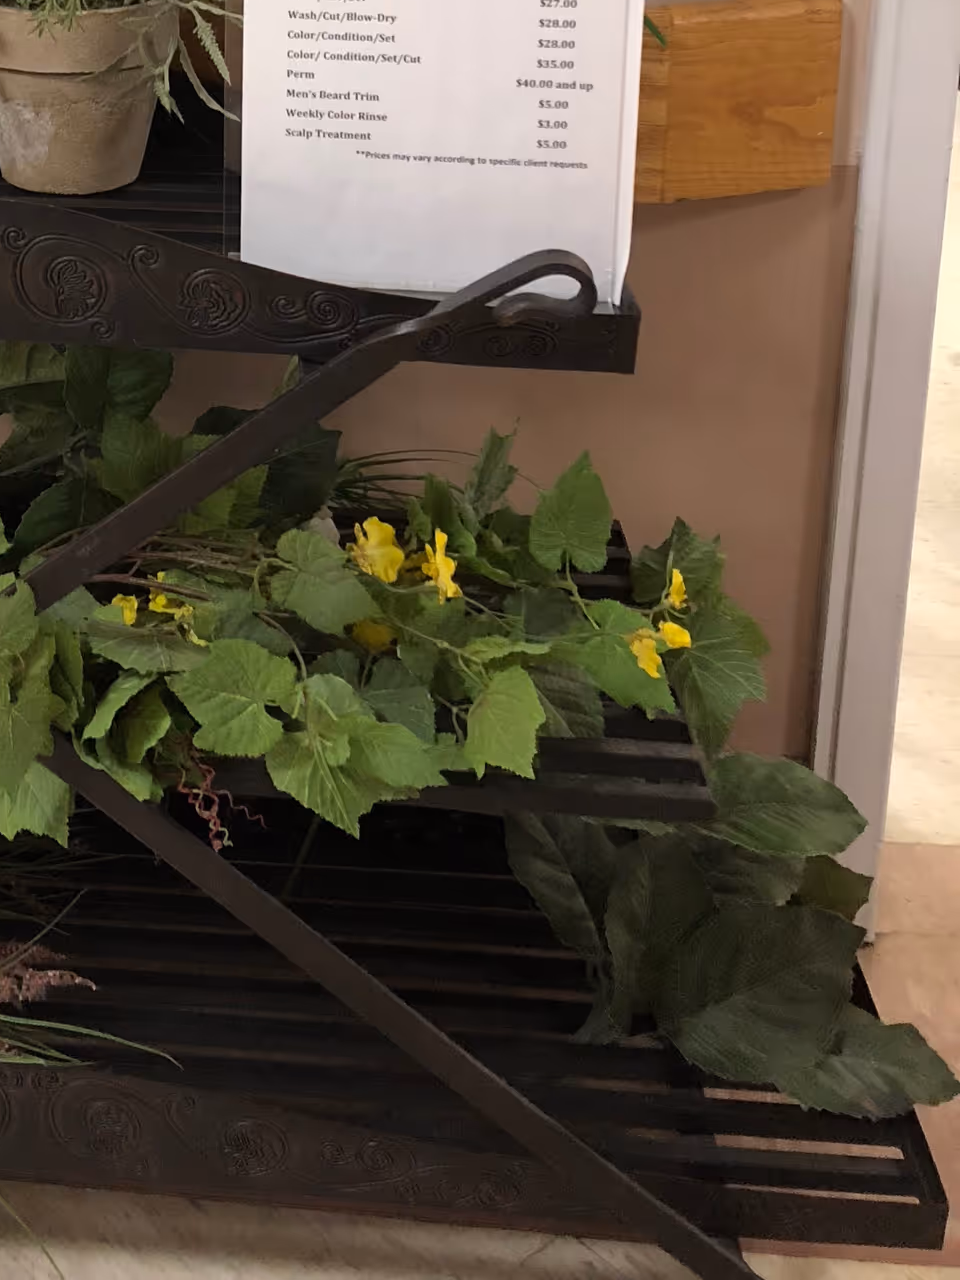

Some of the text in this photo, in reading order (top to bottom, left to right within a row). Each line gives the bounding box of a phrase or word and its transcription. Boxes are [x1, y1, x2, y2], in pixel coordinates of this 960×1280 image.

[288, 11, 396, 24] Wash/Cut/Blow-Dry
[539, 19, 576, 29] $28.00
[288, 30, 395, 44] Color/Condition/Set
[538, 39, 575, 49] $28.00
[537, 59, 574, 69] $35.00
[286, 69, 315, 79] Perm
[516, 79, 593, 92] $40.00 and up
[286, 89, 379, 101] Men's Beard Trim
[538, 100, 569, 109] $5.00
[286, 109, 387, 121] Weekly Color Rinse
[285, 128, 371, 141] Scalp Treatment
[393, 153, 410, 162] may
[413, 154, 431, 163] vary
[433, 155, 475, 165] according
[477, 156, 486, 164] to
[489, 158, 521, 167] specific
[524, 158, 547, 167] client
[550, 160, 588, 169] requests
